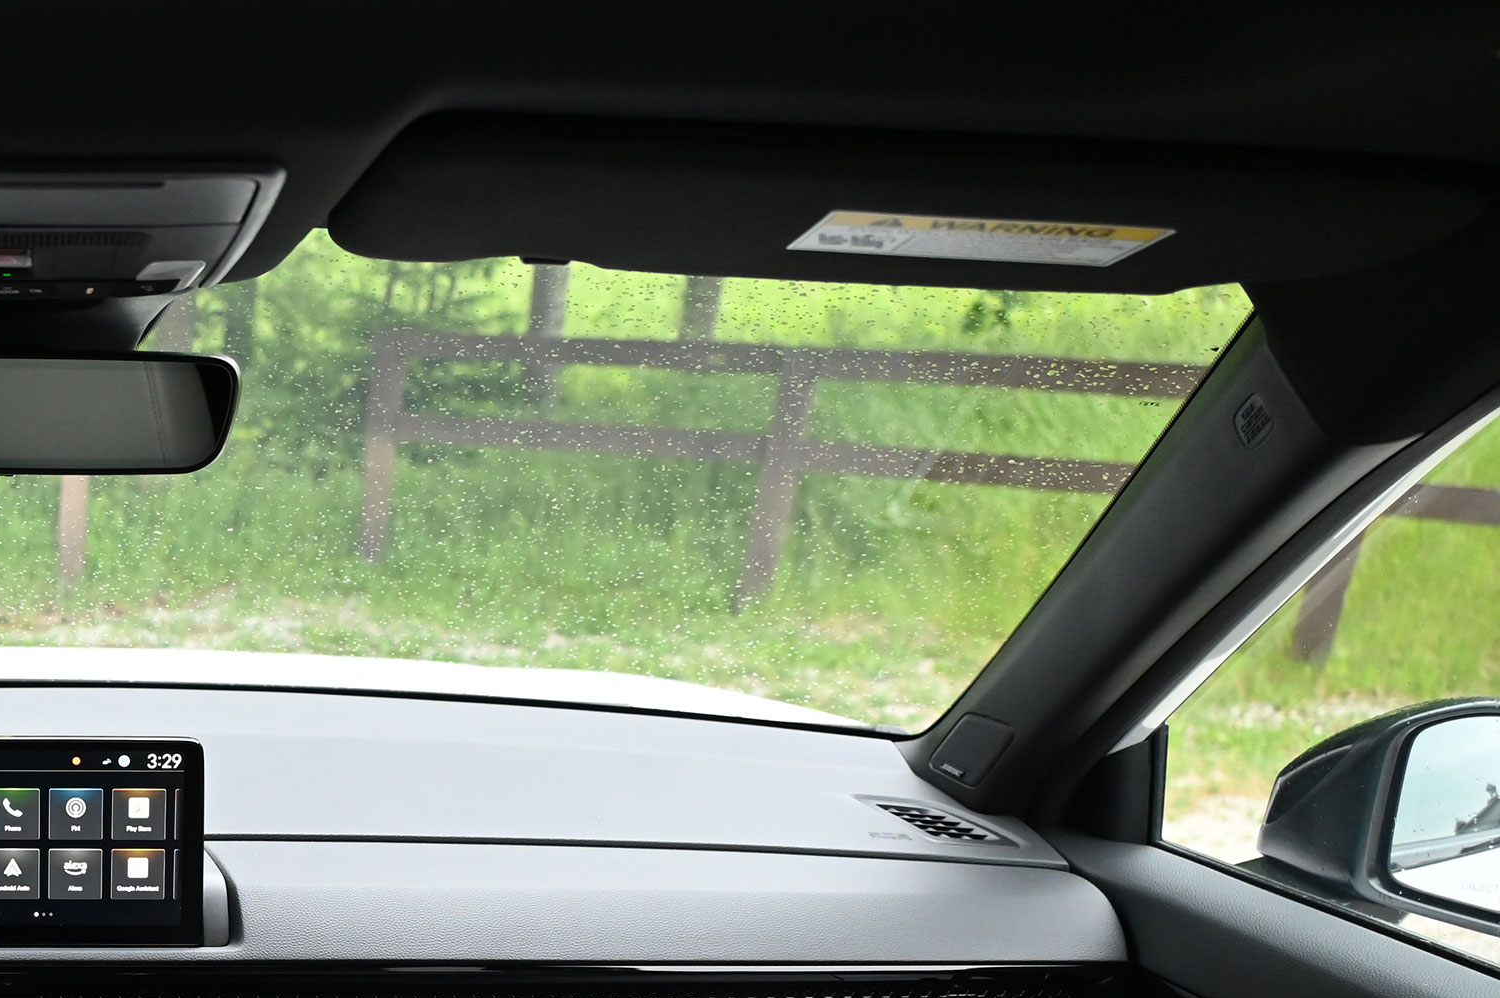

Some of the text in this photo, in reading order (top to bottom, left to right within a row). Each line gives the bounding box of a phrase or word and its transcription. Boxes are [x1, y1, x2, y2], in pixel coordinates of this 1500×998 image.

[930, 218, 1116, 238] WARNING
[147, 753, 182, 769] 3:29
[63, 860, 88, 870] alexa
[1461, 880, 1500, 894] OBJECT
